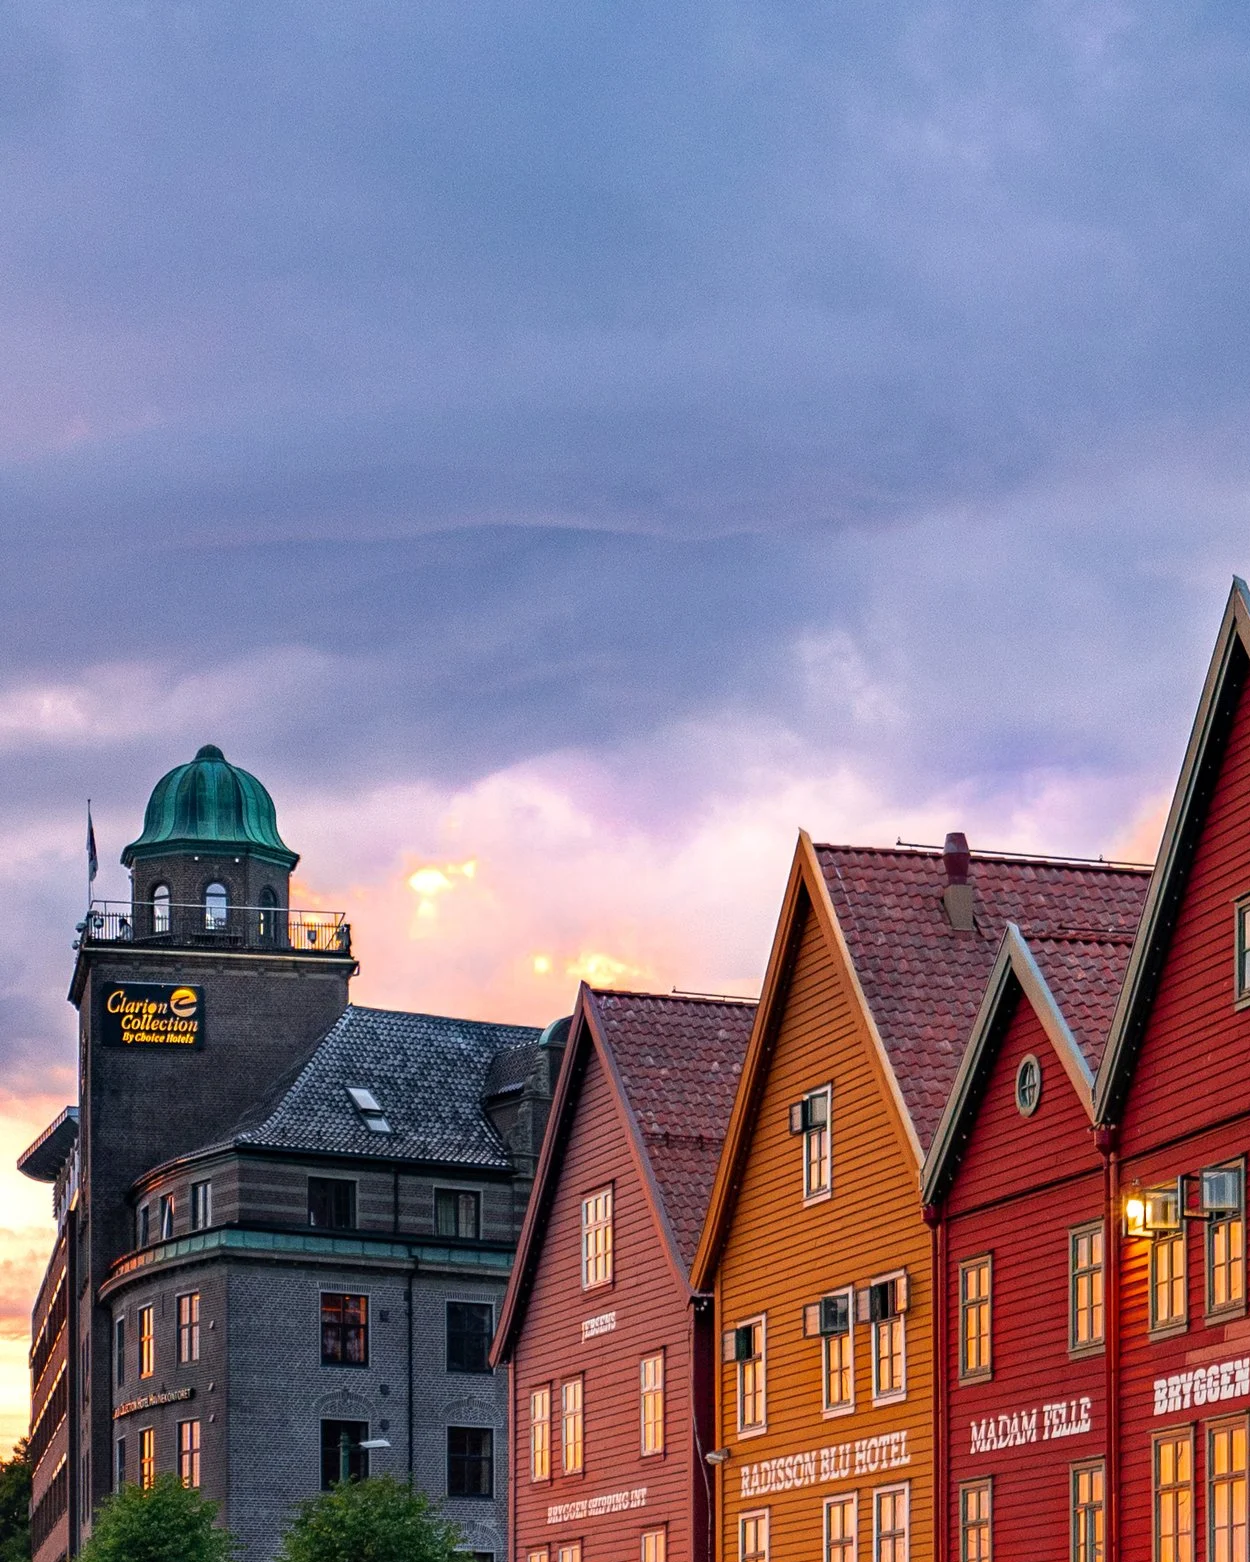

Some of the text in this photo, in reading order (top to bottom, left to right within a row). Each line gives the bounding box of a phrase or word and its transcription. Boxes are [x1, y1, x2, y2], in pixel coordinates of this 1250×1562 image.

[106, 990, 168, 1014] Clarion
[121, 1014, 198, 1032] Collection
[122, 1031, 194, 1044] By Choice Hotels
[1152, 1357, 1250, 1416] BRYGGEN
[969, 1396, 1092, 1455] MADAM FELLE
[740, 1430, 912, 1498] RADISSON BLU HOTEL
[546, 1487, 648, 1525] BRYGGEN SHIPPING INT
